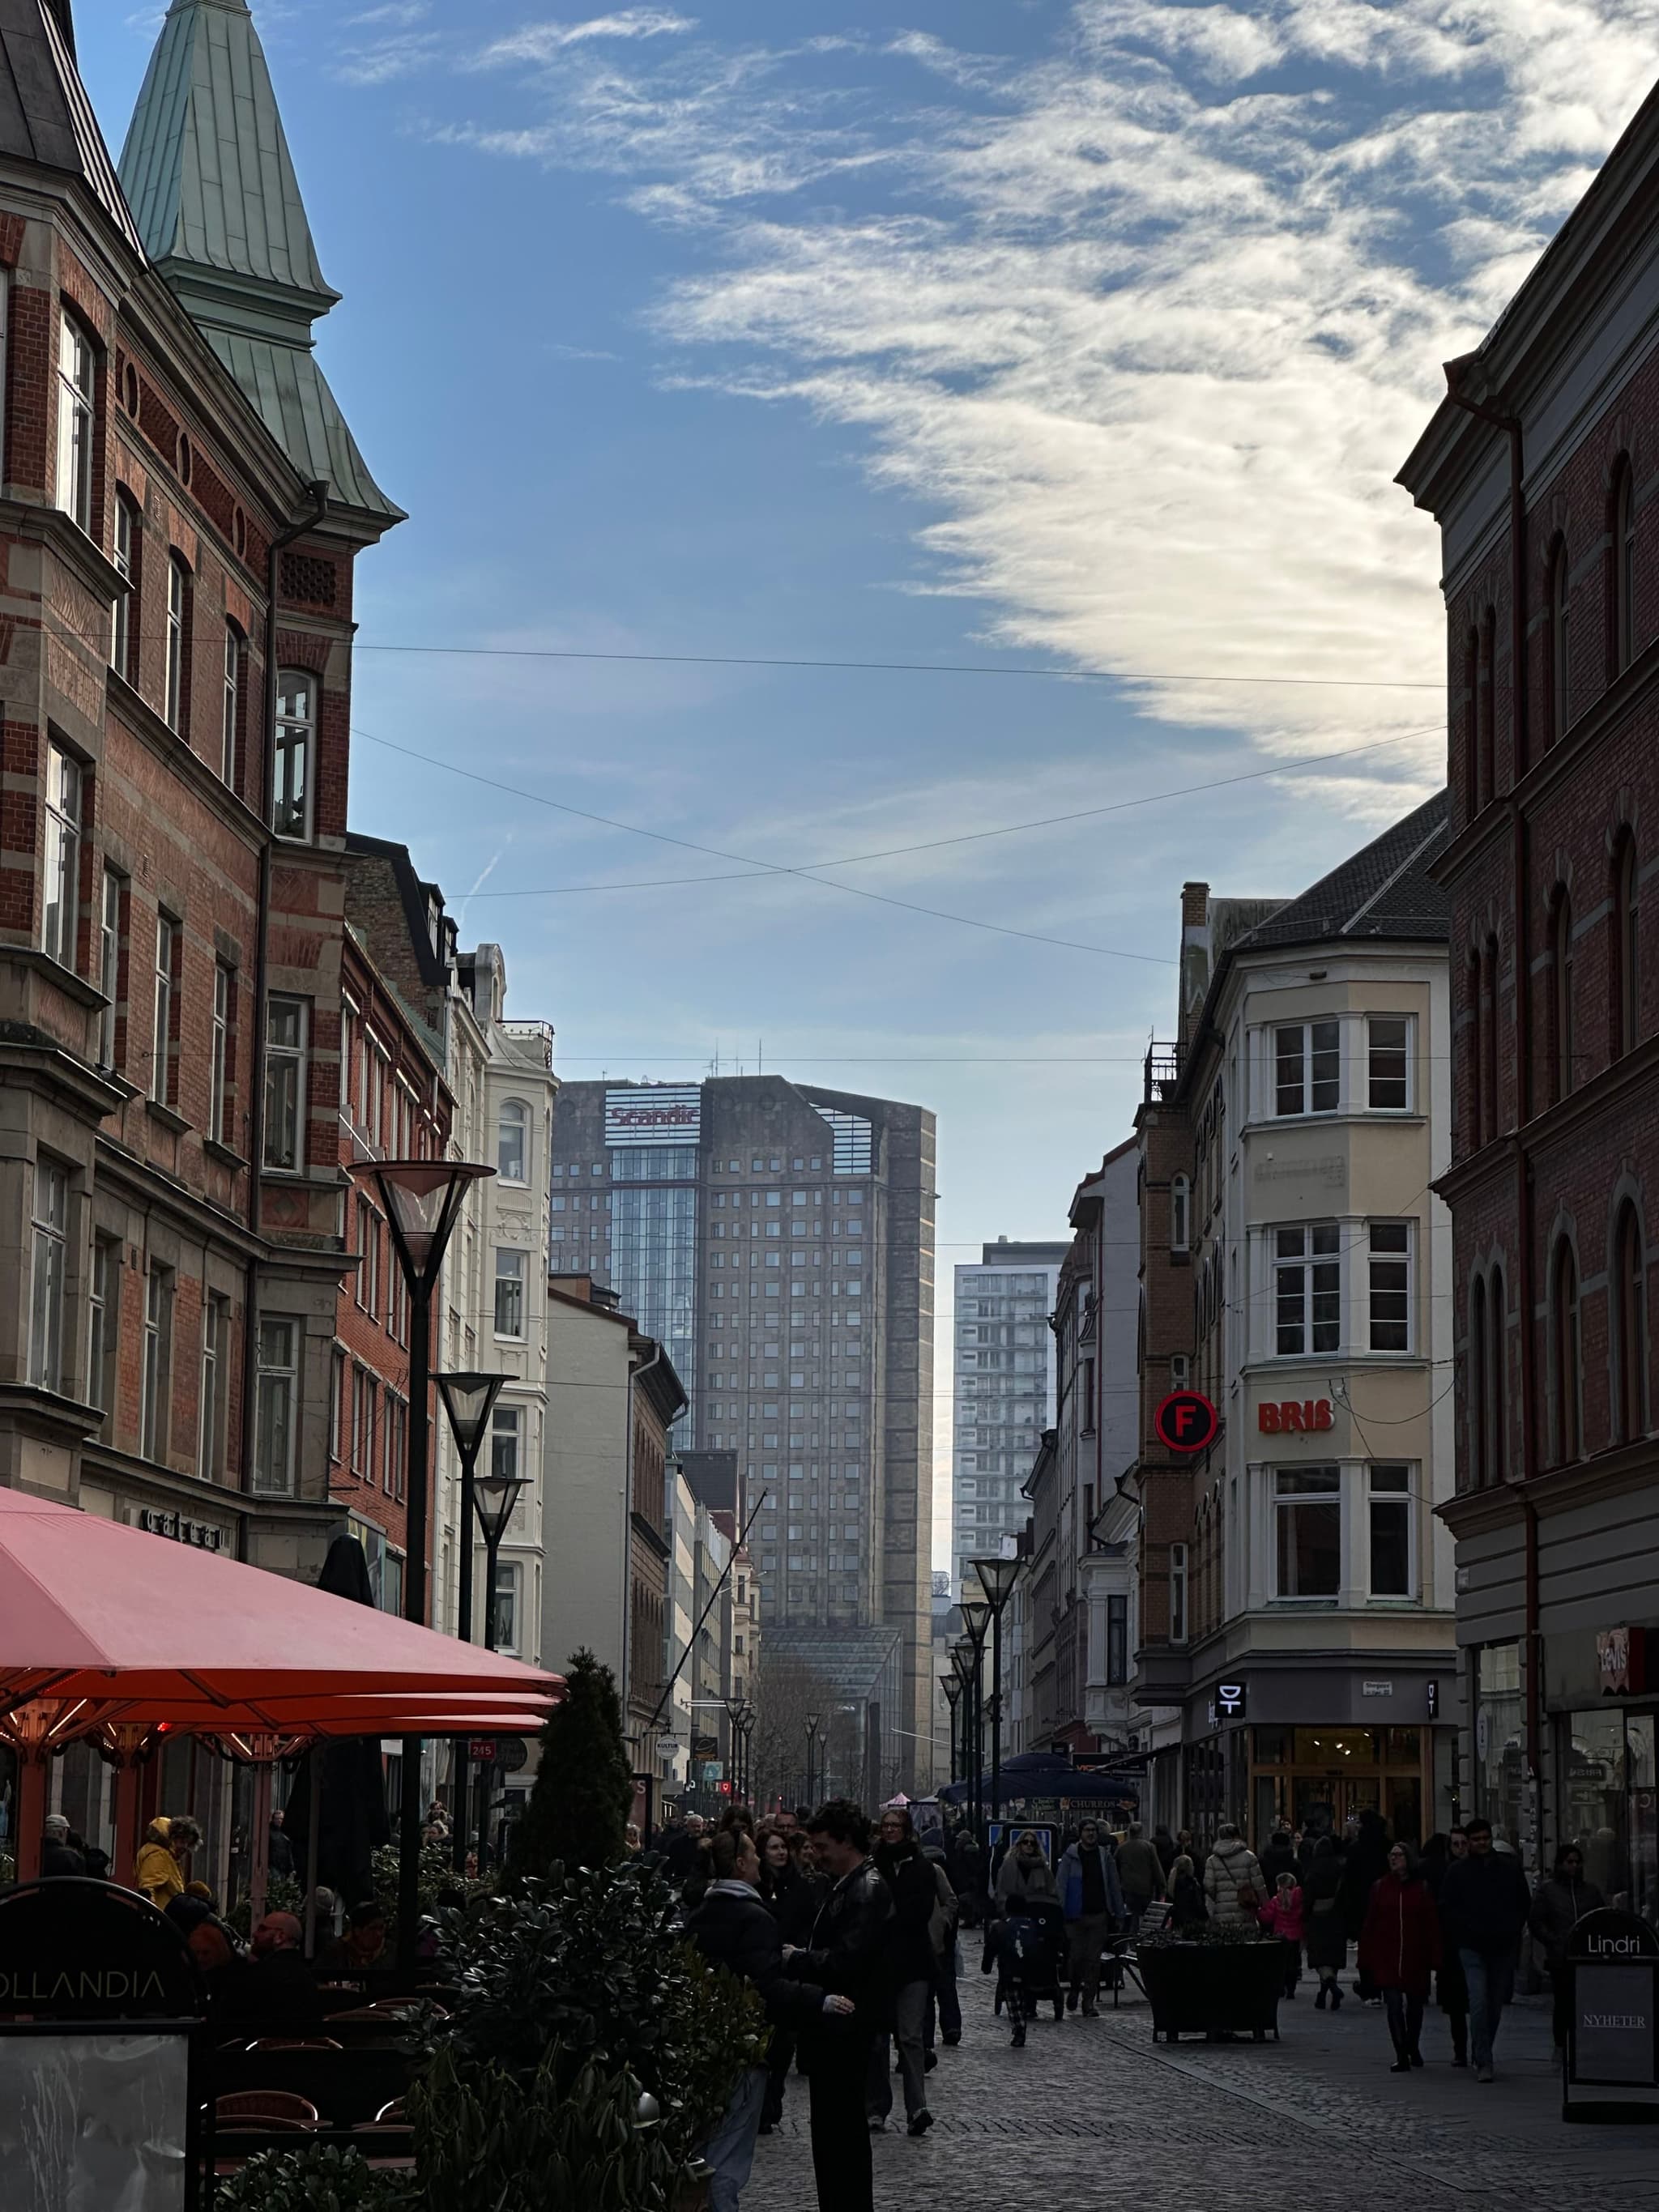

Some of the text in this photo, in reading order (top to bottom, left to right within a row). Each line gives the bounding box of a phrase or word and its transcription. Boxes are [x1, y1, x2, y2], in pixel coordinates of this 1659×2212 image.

[611, 1105, 699, 1126] Scandic
[1176, 1405, 1197, 1438] F
[1259, 1399, 1335, 1433] BRIS
[472, 1746, 493, 1756] 245
[1588, 1933, 1640, 1954] Lindri
[1584, 2014, 1646, 2028] NYHETER
